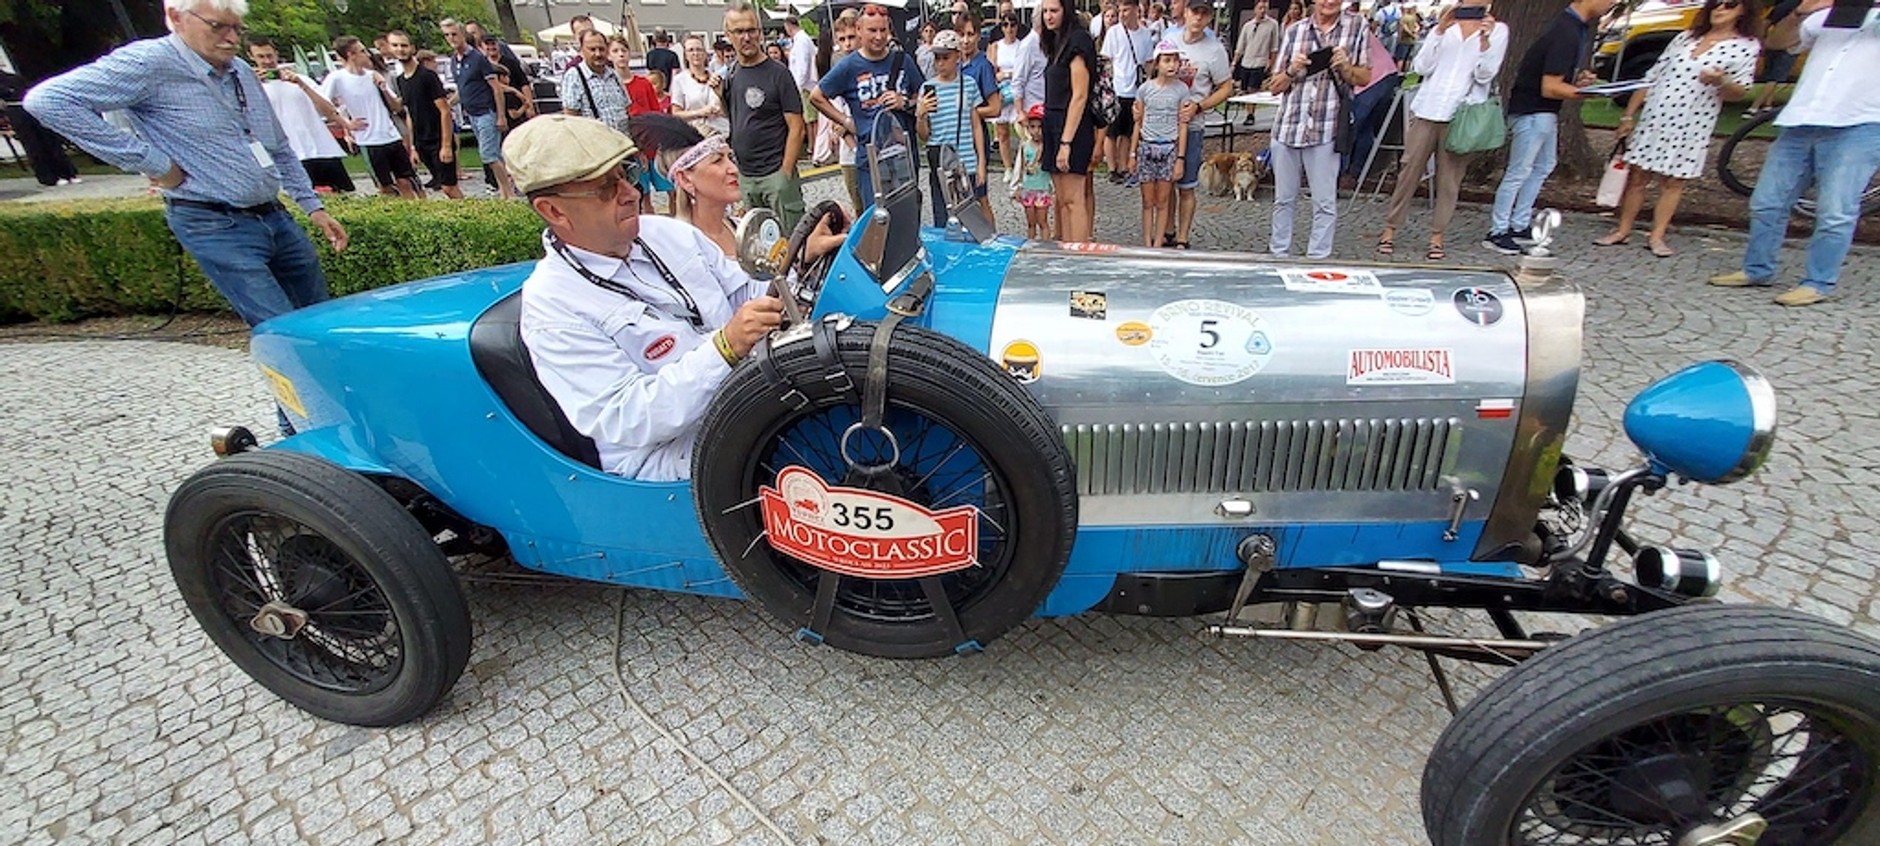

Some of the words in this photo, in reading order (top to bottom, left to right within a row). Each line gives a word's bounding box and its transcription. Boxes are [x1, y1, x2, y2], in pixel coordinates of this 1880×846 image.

[1158, 301, 1200, 322] BRNO
[1204, 301, 1260, 327] REVIVAL
[1200, 319, 1220, 349] 5
[1348, 349, 1448, 379] AUTOMOBILISTA
[833, 503, 894, 531] 355
[773, 512, 967, 562] MOTOCLASSIC
